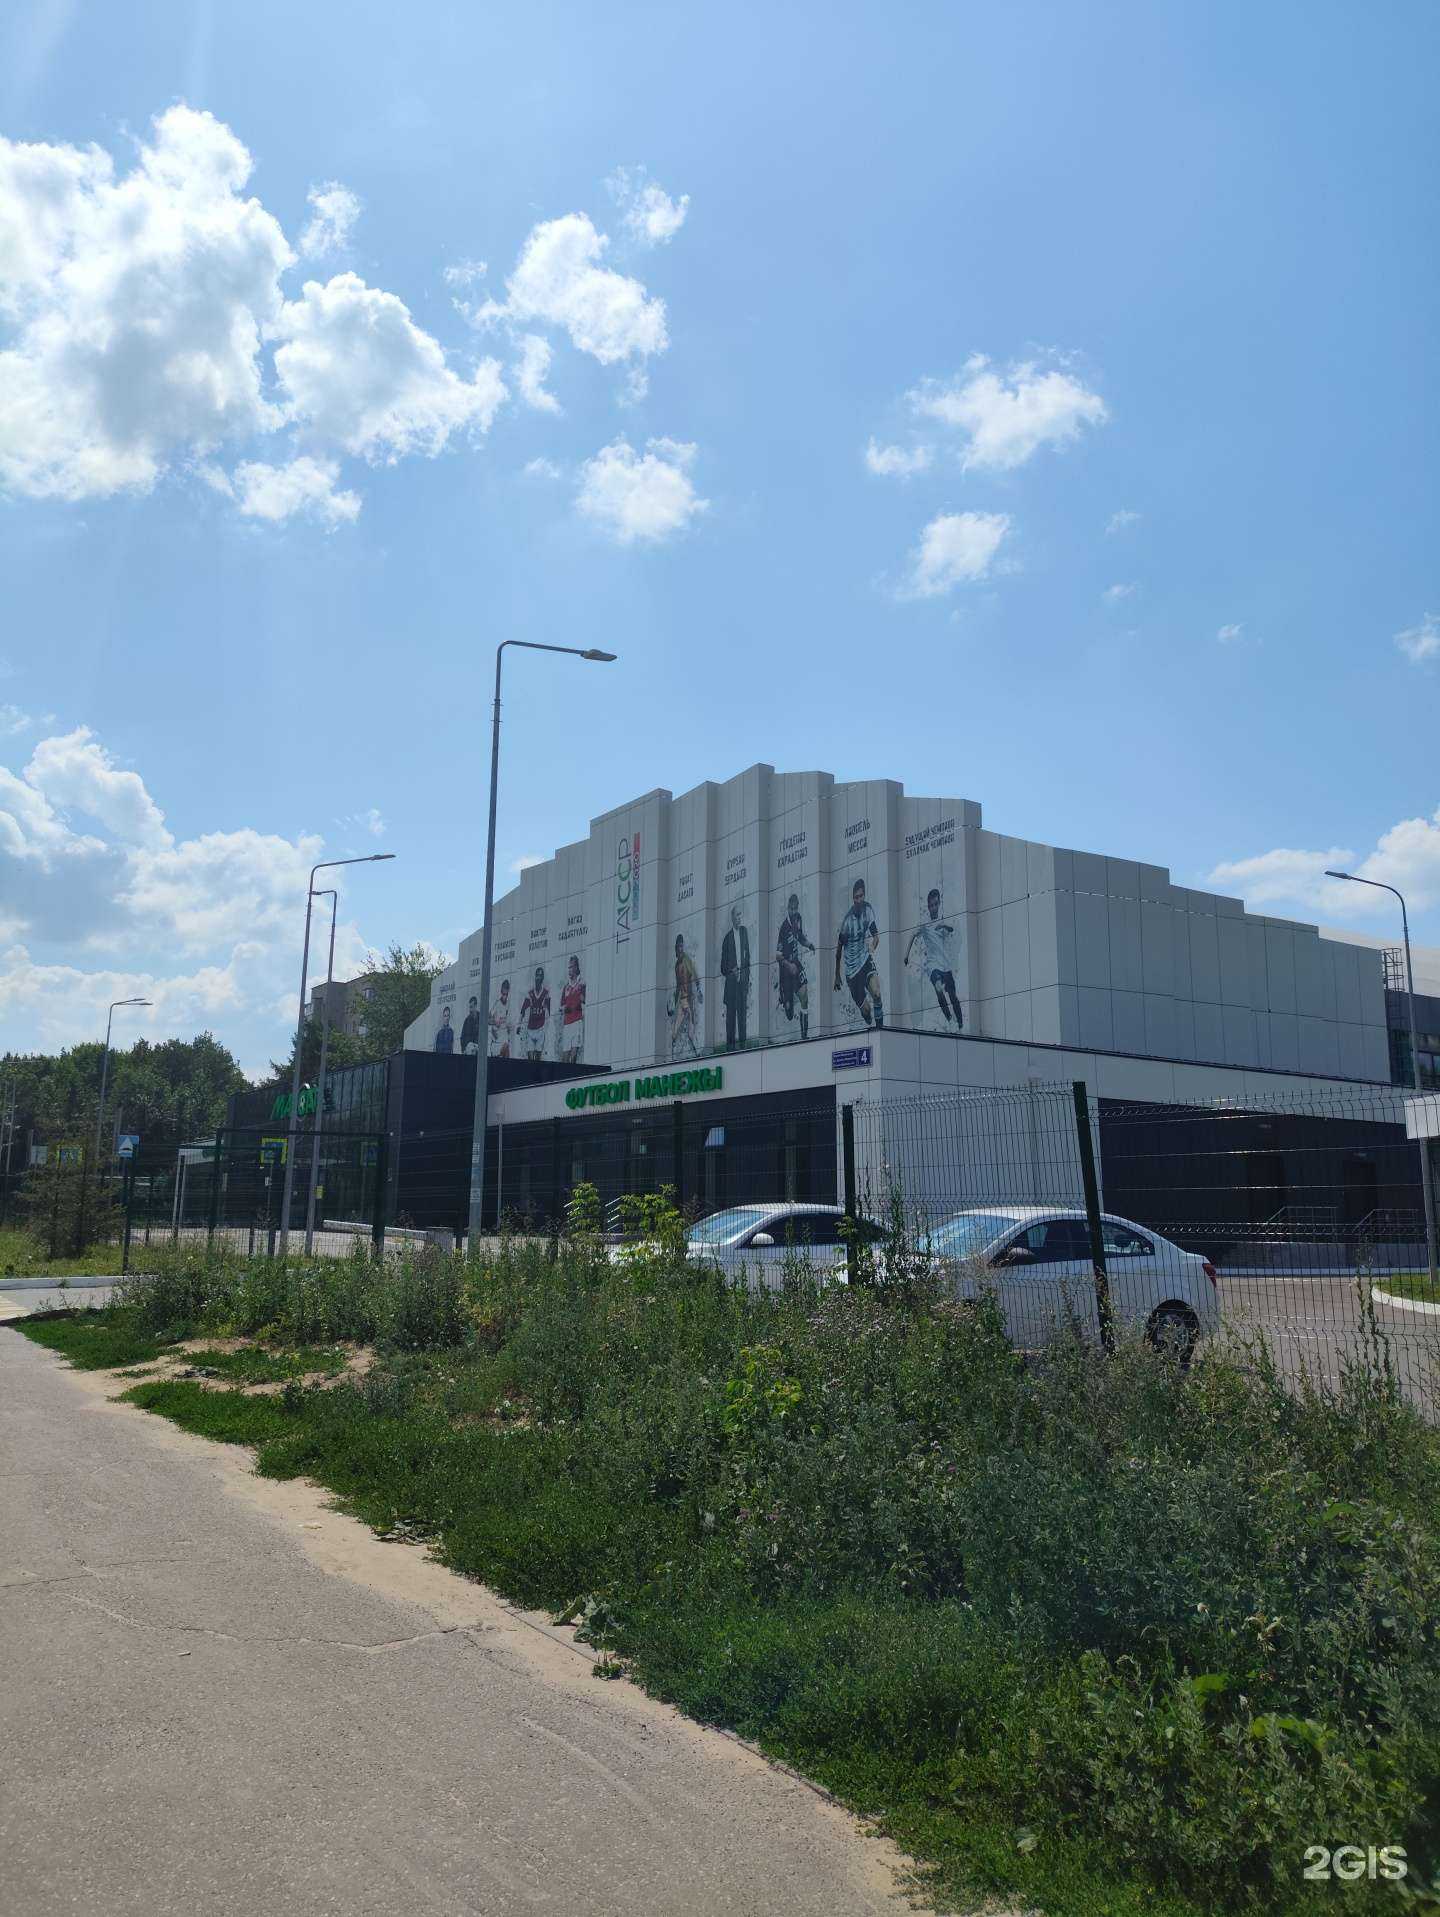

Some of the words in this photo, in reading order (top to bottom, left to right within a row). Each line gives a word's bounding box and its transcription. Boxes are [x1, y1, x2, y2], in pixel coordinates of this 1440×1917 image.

[860, 1050, 868, 1063] 4
[565, 1079, 631, 1110] ФУТБОЛ
[634, 1065, 724, 1101] МАНЕЖЫ
